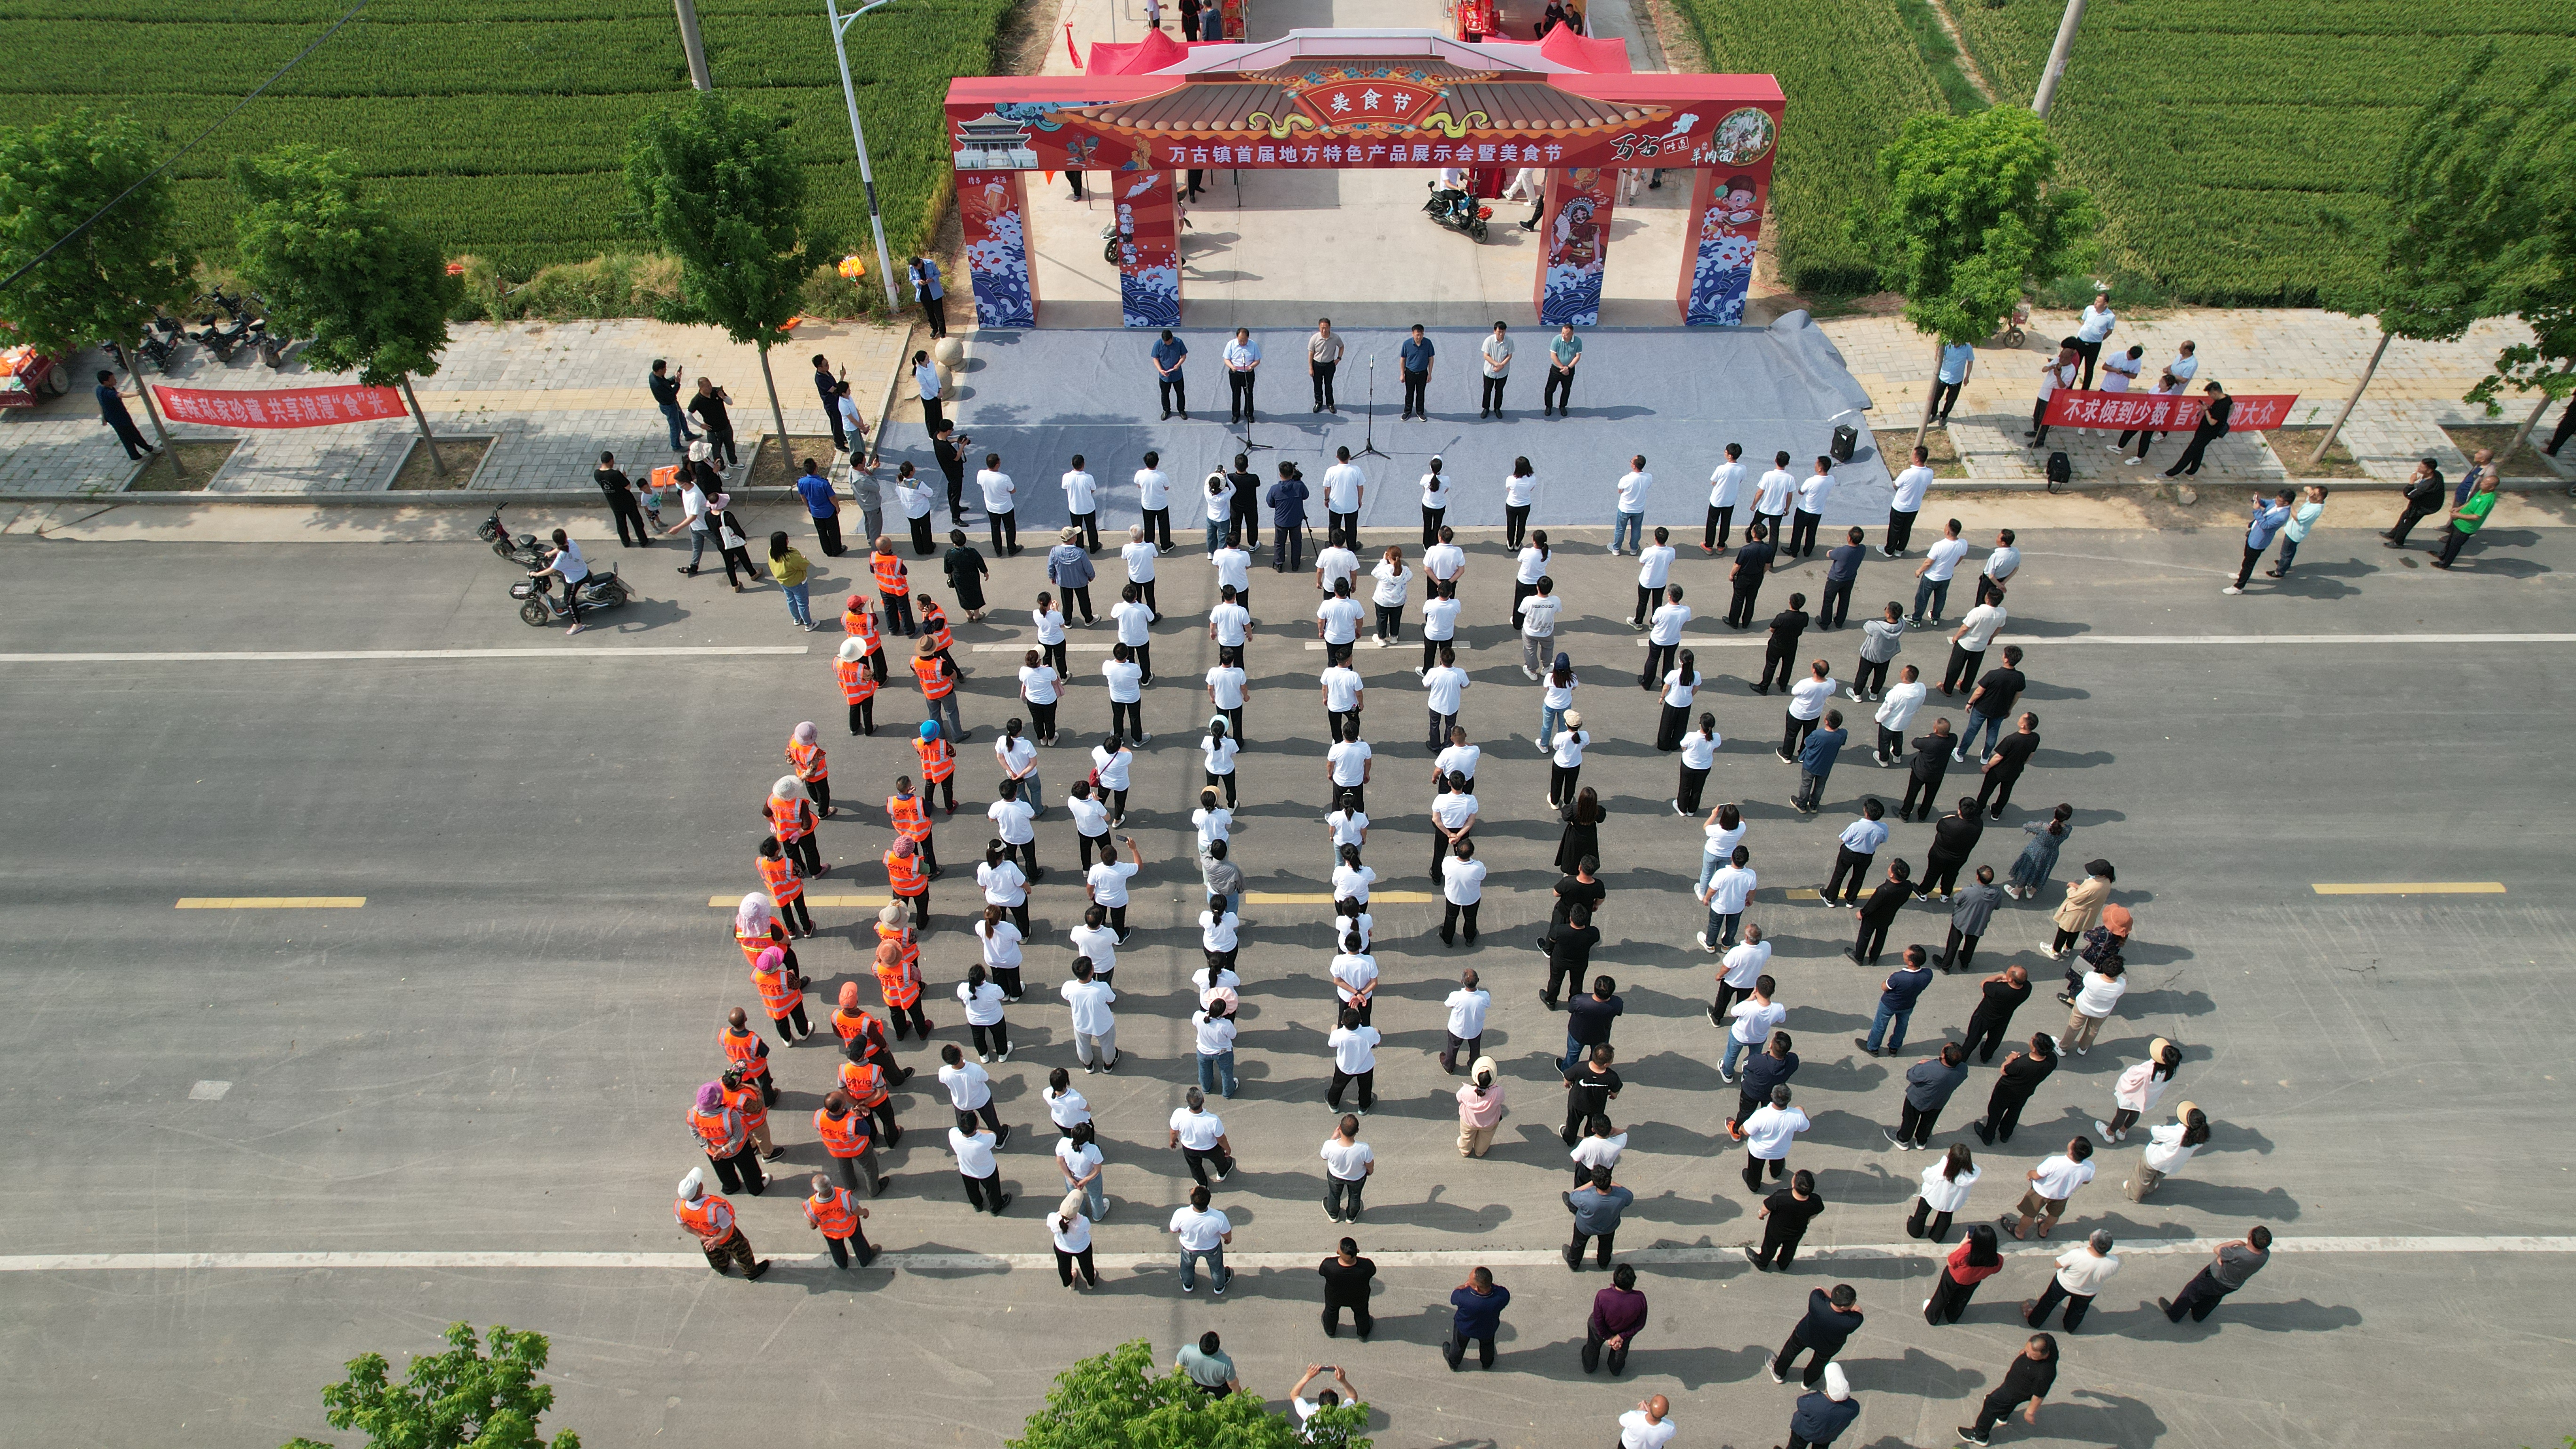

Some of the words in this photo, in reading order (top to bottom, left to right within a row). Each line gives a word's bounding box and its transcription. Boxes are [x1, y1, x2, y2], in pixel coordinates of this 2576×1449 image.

[1330, 88, 1411, 115] 美食节
[1168, 144, 1563, 163] 万古镇首届地方特色产品展示会暨美食节
[1666, 139, 1688, 151] 味道
[1691, 147, 1734, 166] 羊肉面
[170, 394, 267, 423] 美味私家珍藏
[2064, 399, 2171, 426] 不求倾到少数
